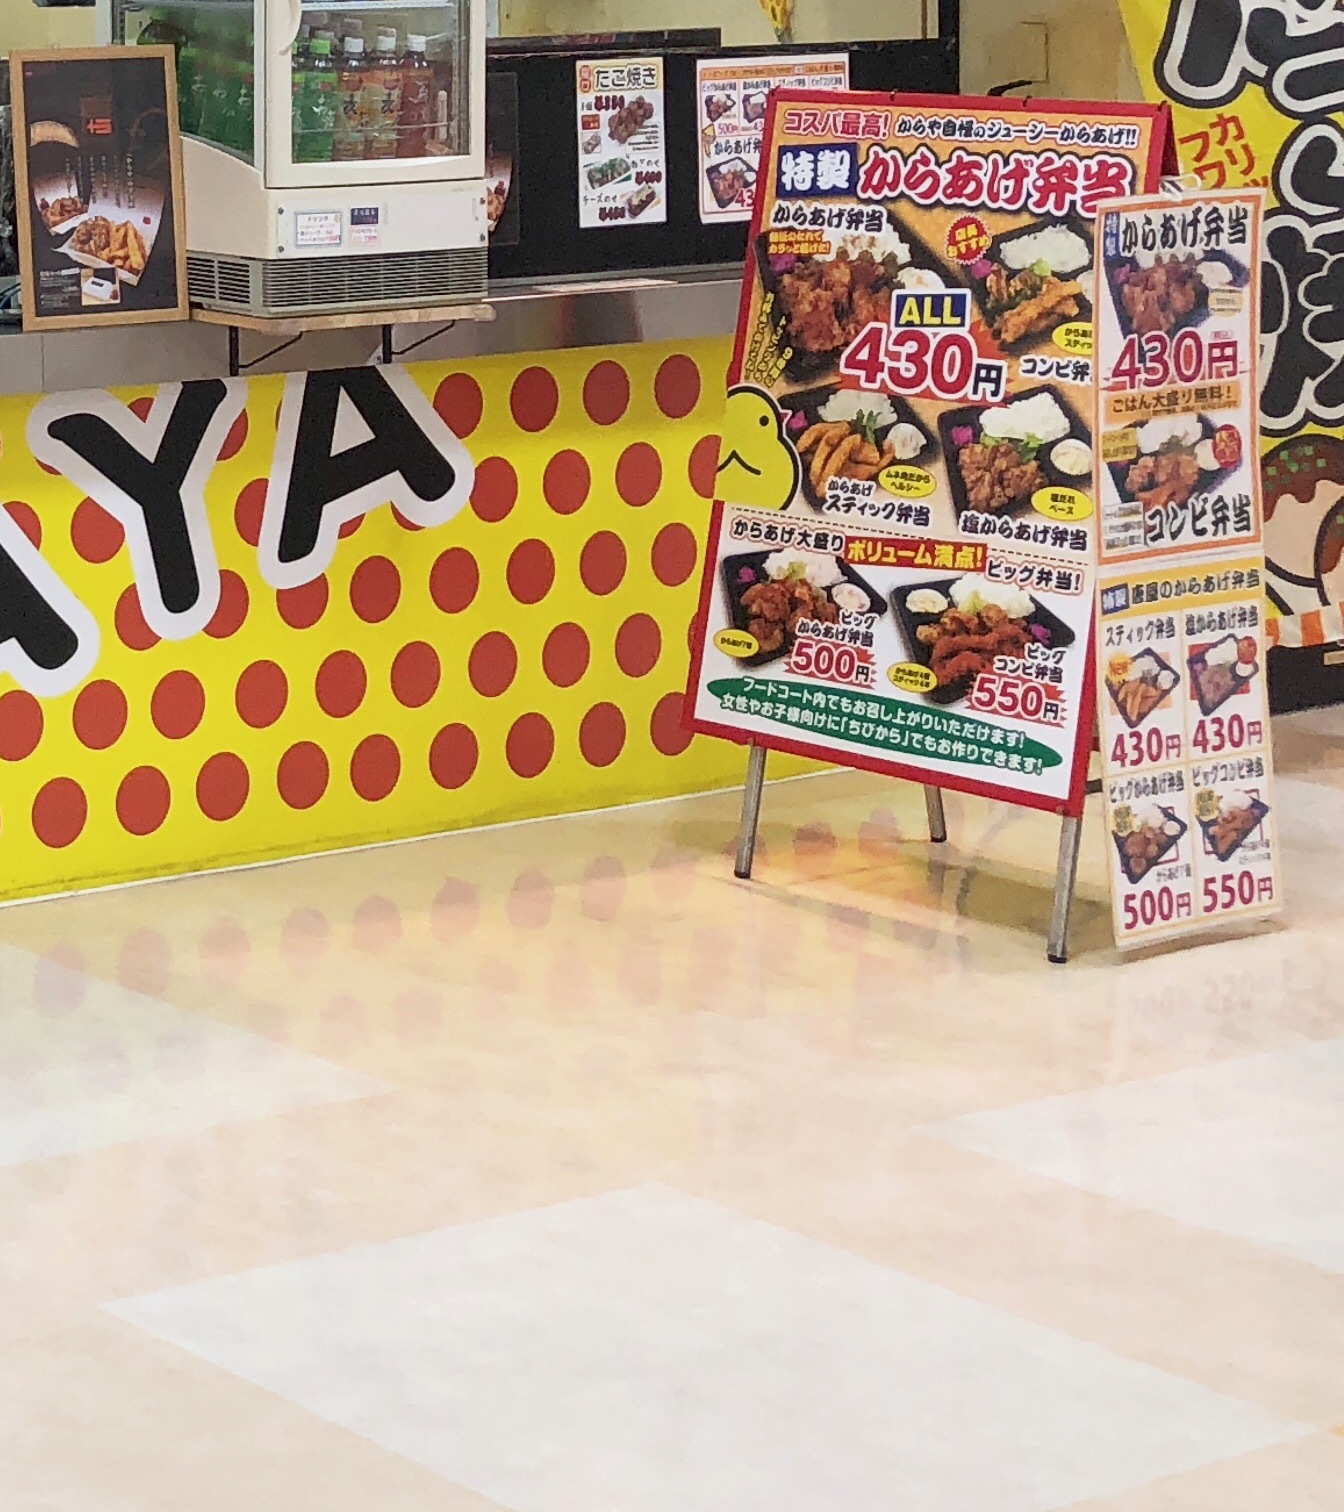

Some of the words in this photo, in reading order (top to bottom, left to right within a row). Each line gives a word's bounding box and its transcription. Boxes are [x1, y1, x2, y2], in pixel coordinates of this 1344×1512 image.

[595, 67, 656, 88] たこ焼き
[783, 110, 889, 139] コスパ最高!
[897, 117, 1138, 148] からや自慢のジューシーからあげ!!
[781, 150, 852, 191] 特製
[861, 151, 1132, 217] からあげ弁当
[772, 204, 885, 232] からあげ弁当
[1122, 206, 1249, 254] からあげ弁当
[899, 296, 962, 325] ALL
[844, 327, 1002, 397] 430円
[1112, 330, 1238, 390] 430円
[826, 494, 931, 527] スティック弁当
[1146, 494, 1252, 546] コンビ弁当
[962, 513, 1088, 551] 塩からあげ弁当
[733, 520, 844, 552] からあげ大盛り
[847, 540, 984, 568] ボリューム満点!
[988, 562, 1082, 591] ビッグ弁当!
[797, 622, 874, 647] からあげ弁当
[841, 610, 876, 627] ビッグ
[791, 642, 870, 683] 500円
[994, 657, 1063, 683] コンビ弁当
[1026, 645, 1066, 663] ビッグ
[742, 678, 1027, 748] フードコート内でもお召し上がりいただけます!
[973, 678, 1059, 721] 550円
[1112, 727, 1181, 768] 430円
[1192, 714, 1262, 754] 430円
[1124, 887, 1192, 930] 500円
[1202, 870, 1273, 914] 550円
